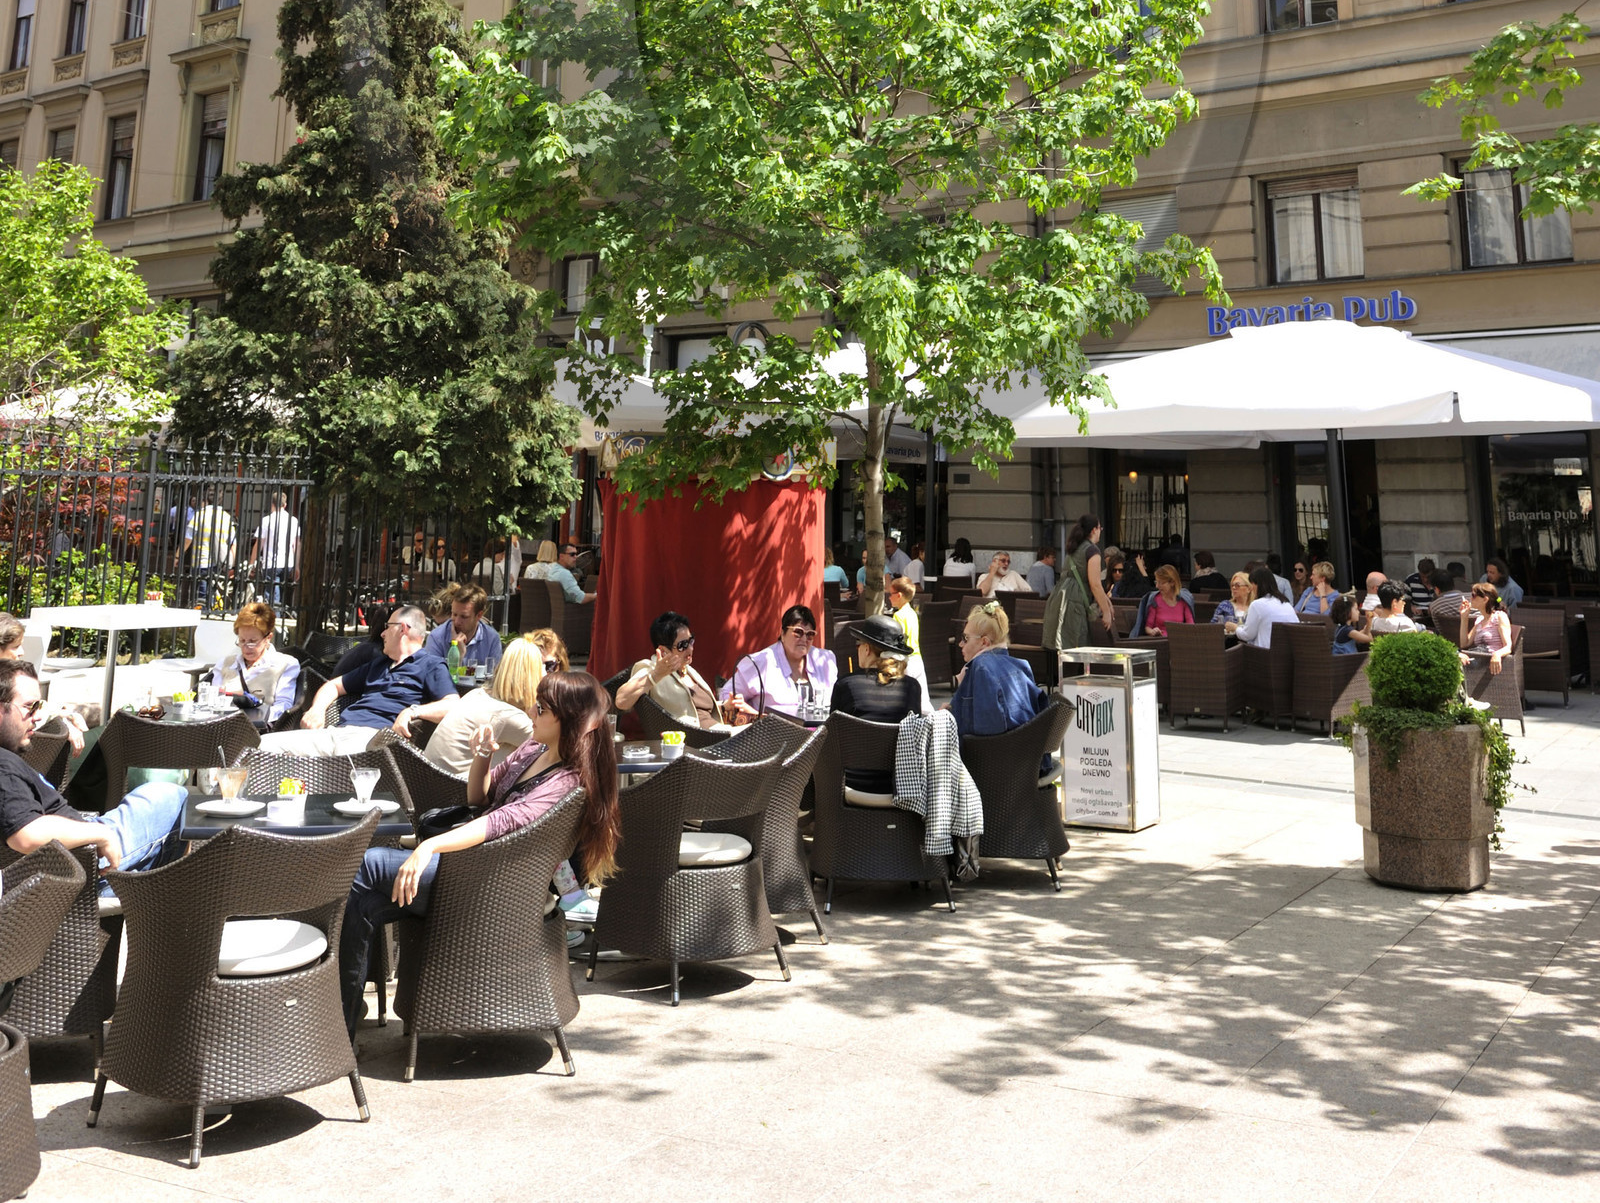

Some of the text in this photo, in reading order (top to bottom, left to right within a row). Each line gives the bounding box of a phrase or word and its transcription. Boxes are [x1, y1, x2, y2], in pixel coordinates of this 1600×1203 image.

[1206, 296, 1334, 337] Bavaria
[1508, 510, 1551, 521] Bavaria
[1082, 747, 1110, 756] MILIJUN
[1079, 757, 1113, 767] POGLEDA
[1082, 768, 1111, 778] DNEVNO
[1095, 788, 1114, 796] urbani
